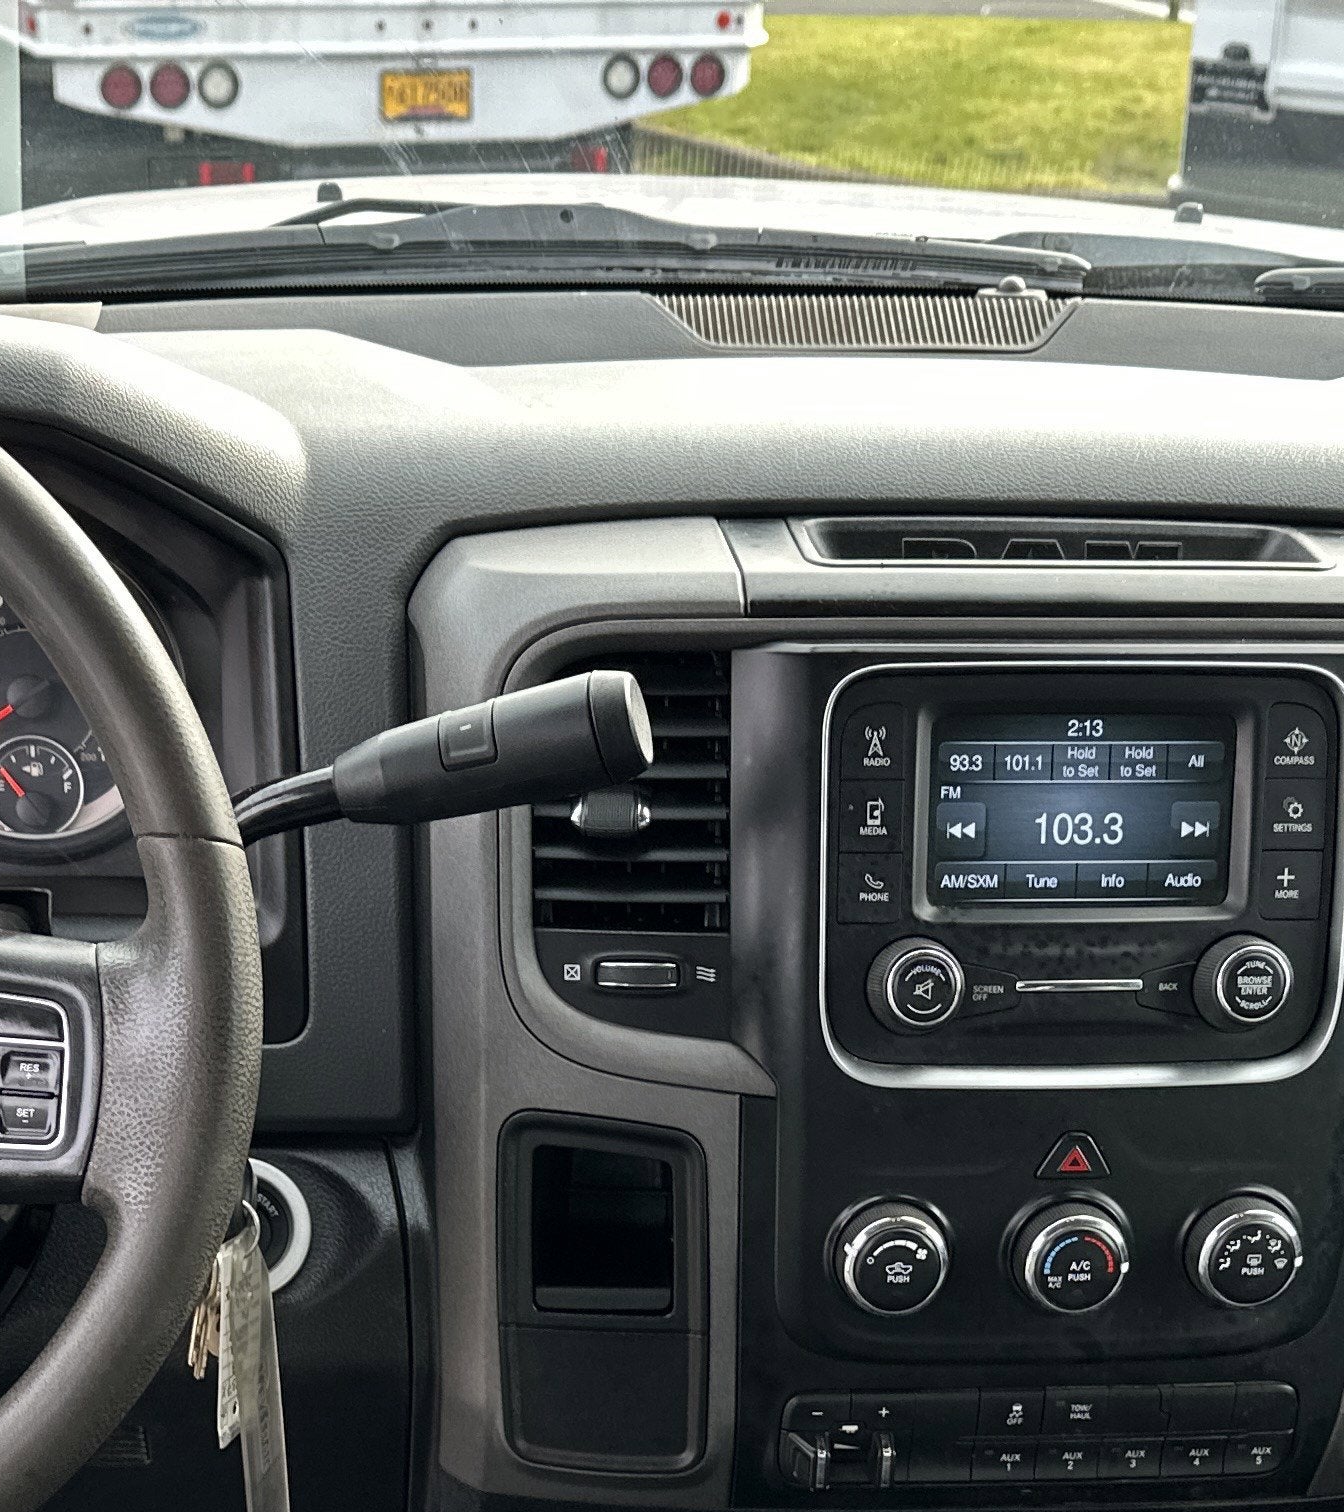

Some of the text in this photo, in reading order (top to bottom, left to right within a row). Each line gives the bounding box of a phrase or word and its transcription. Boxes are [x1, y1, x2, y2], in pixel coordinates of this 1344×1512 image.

[1068, 719, 1103, 737] 2:13
[1067, 747, 1096, 760] Hold
[1125, 747, 1153, 760] Hold
[864, 757, 890, 766] RADIO
[950, 755, 982, 771] 93.3
[1005, 755, 1043, 771] 101.1
[1188, 755, 1205, 768] All
[1273, 756, 1315, 766] COMPASS
[1063, 765, 1098, 778] to Set
[1120, 765, 1156, 777] to Set
[941, 787, 961, 799] FM
[860, 827, 887, 835] MEDIA
[1033, 811, 1124, 846] 103.3
[1273, 824, 1312, 833] SETTINGS
[940, 874, 998, 889] AM/SXM
[1026, 875, 1058, 888] Tune
[1101, 874, 1124, 887] Info
[1164, 874, 1201, 887] Audio
[859, 892, 889, 902] PHONE
[1275, 890, 1298, 898] MORE
[1237, 976, 1272, 985] BROWSE
[973, 985, 1004, 994] SCREEN
[1158, 983, 1178, 991] BACK
[1240, 986, 1269, 995] ENTER
[972, 993, 987, 1001] OFF
[20, 1063, 40, 1073] RES
[16, 1108, 35, 1117] SET
[1070, 1261, 1091, 1271] A/C
[1241, 1267, 1264, 1276] PUSH
[887, 1275, 910, 1284] PUSH
[1068, 1272, 1091, 1282] PUSH
[1070, 1411, 1091, 1420] HAUL
[1006, 1417, 1023, 1426] OFF
[1125, 1450, 1145, 1459] AUX
[1189, 1448, 1209, 1457] AUX
[1251, 1446, 1271, 1455] AUX
[1000, 1453, 1020, 1463] AUX
[1063, 1451, 1082, 1460] AUX
[1067, 1460, 1074, 1470] 2
[1130, 1459, 1136, 1468] 3
[1193, 1457, 1200, 1466] 4
[1255, 1456, 1262, 1465] 5
[1006, 1462, 1011, 1471] 1
